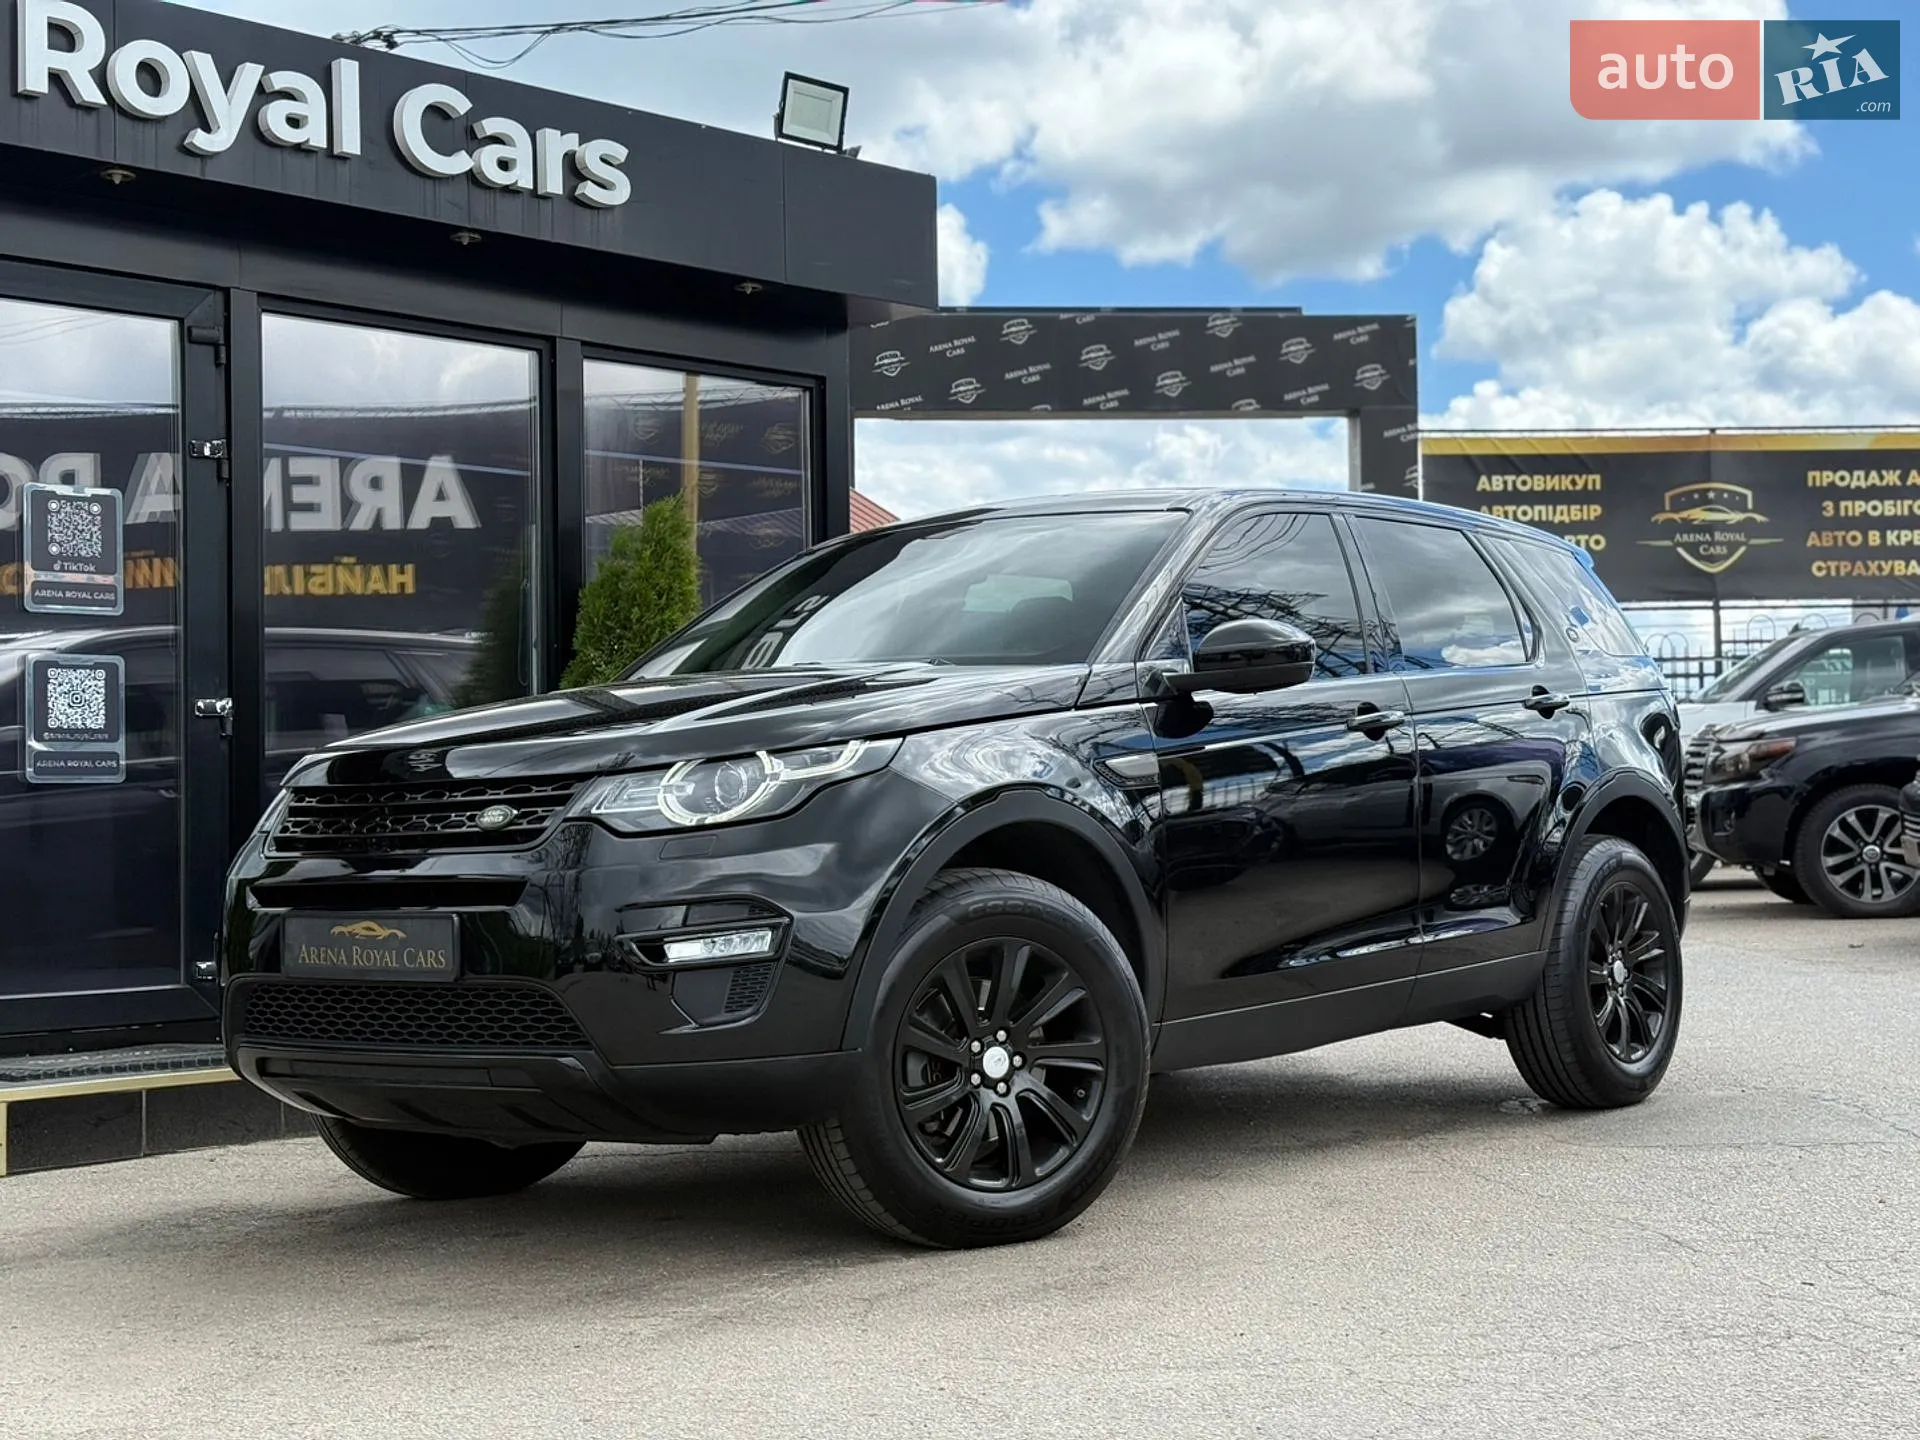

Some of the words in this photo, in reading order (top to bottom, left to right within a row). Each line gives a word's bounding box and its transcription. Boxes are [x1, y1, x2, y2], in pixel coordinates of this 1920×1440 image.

[17, 0, 361, 157] Royal
[393, 83, 632, 208] Cars
[1476, 474, 1601, 492] АВТОВИКУП
[1807, 469, 1902, 489] ПРОДАЖ
[1674, 532, 1711, 543] ARENA
[1714, 530, 1746, 542] ROYAL
[1806, 530, 1863, 547] АВТО
[1868, 530, 1881, 546] В
[1699, 544, 1728, 555] CARS
[63, 563, 97, 573] TikTok
[1811, 559, 1920, 577] СТРАХУВА
[34, 588, 64, 599] ARENA
[65, 590, 92, 600] ROYAL
[93, 591, 115, 600] CARS
[67, 759, 94, 768] ROYAL
[95, 759, 118, 769] CARS
[298, 943, 347, 965] ARENA
[352, 945, 399, 968] ROYAL
[403, 947, 446, 969] CARS
